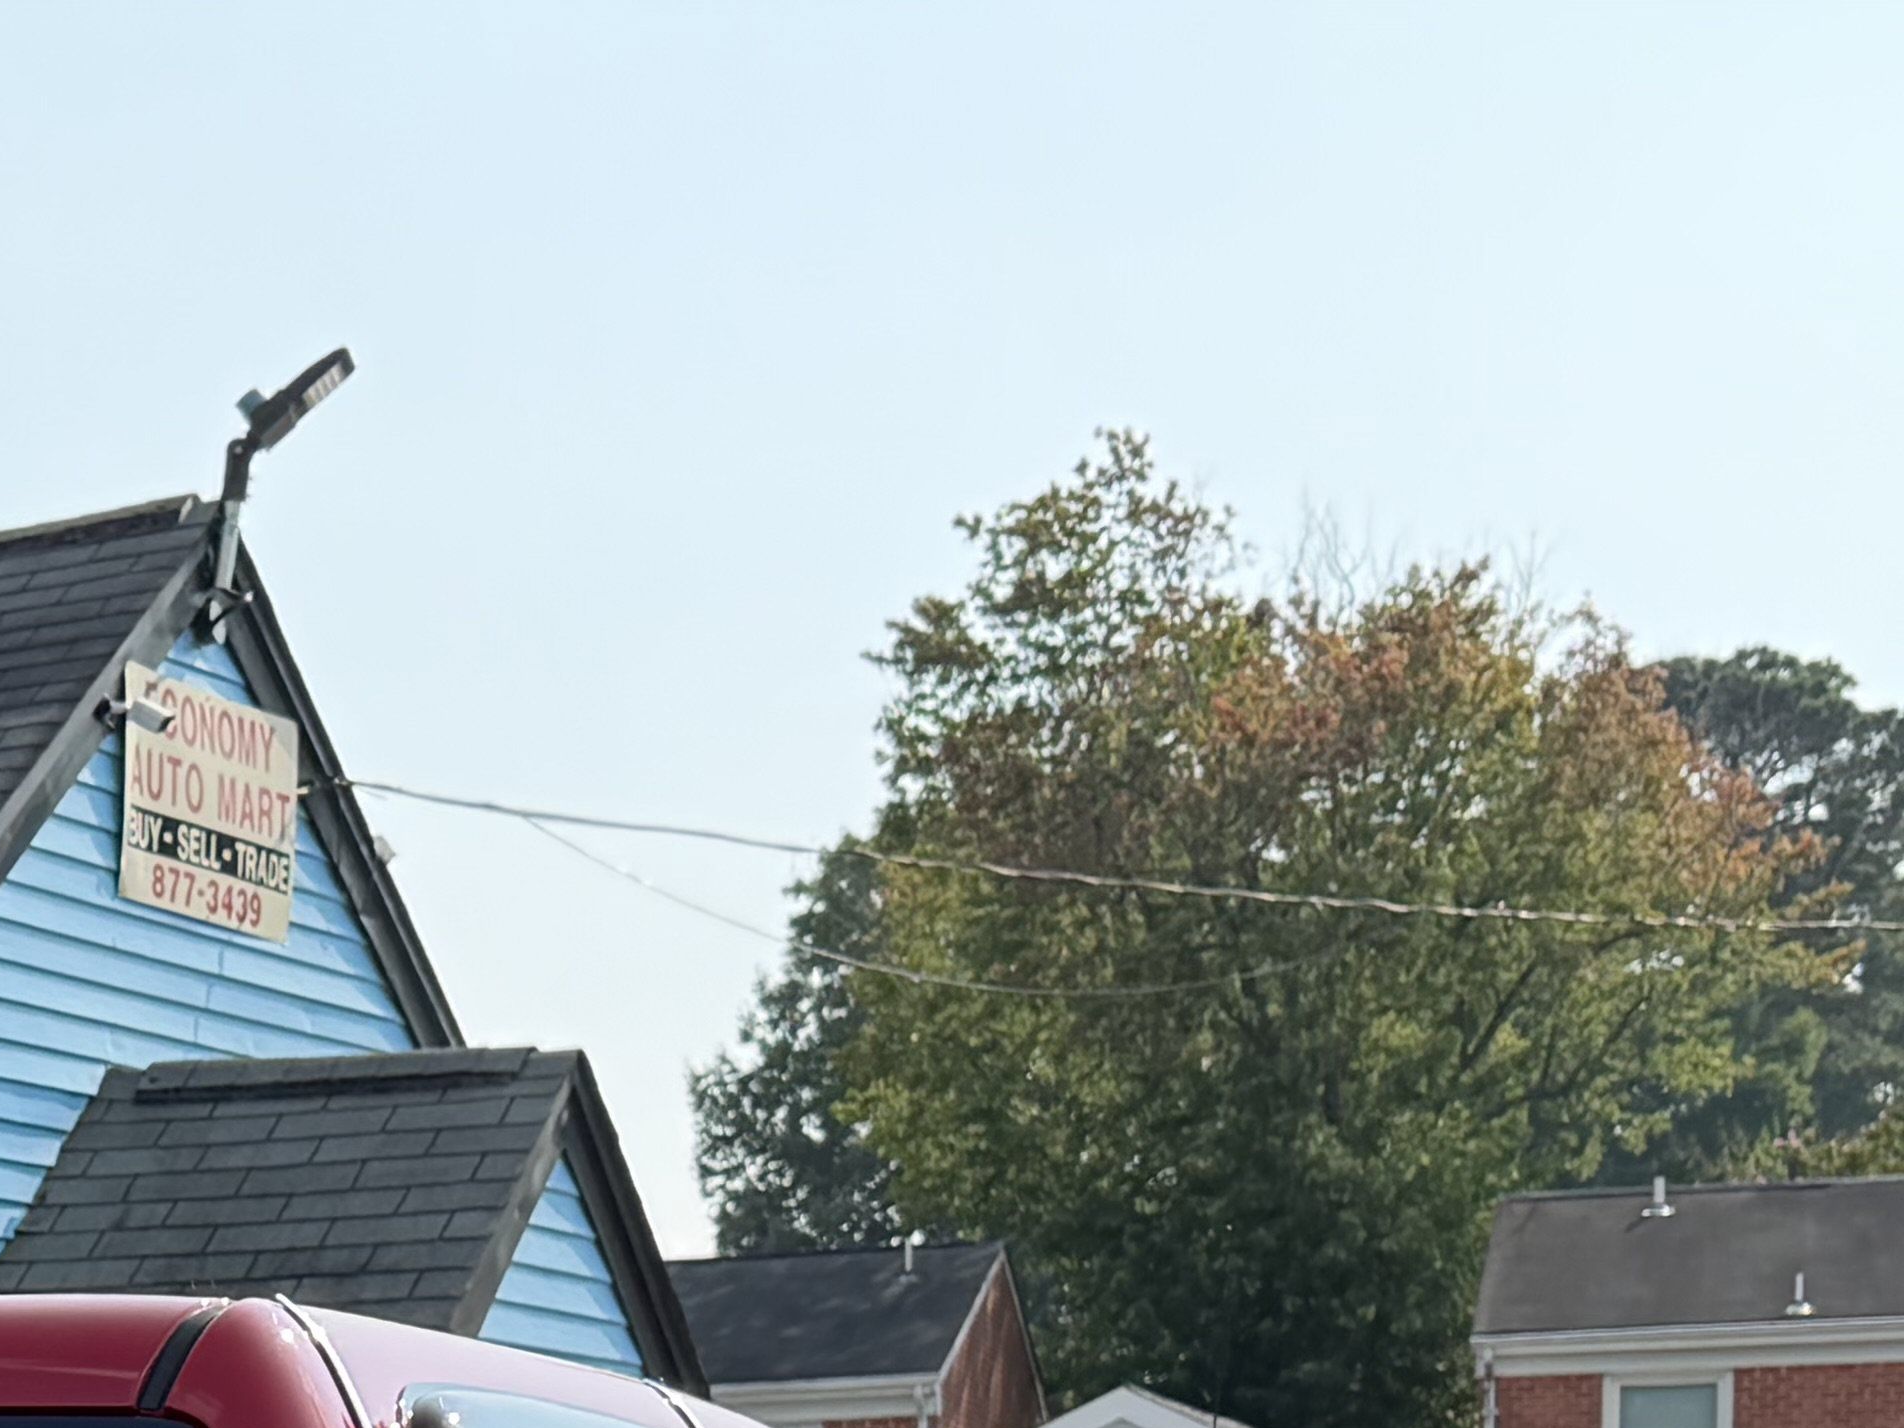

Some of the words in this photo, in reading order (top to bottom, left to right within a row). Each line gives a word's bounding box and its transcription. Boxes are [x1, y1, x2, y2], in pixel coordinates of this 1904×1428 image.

[131, 743, 204, 814] AUTO
[218, 774, 291, 844] MART
[128, 810, 163, 852] BUY
[177, 824, 222, 871] SELL
[234, 842, 290, 892] TRADE
[152, 863, 262, 928] 877-3439
